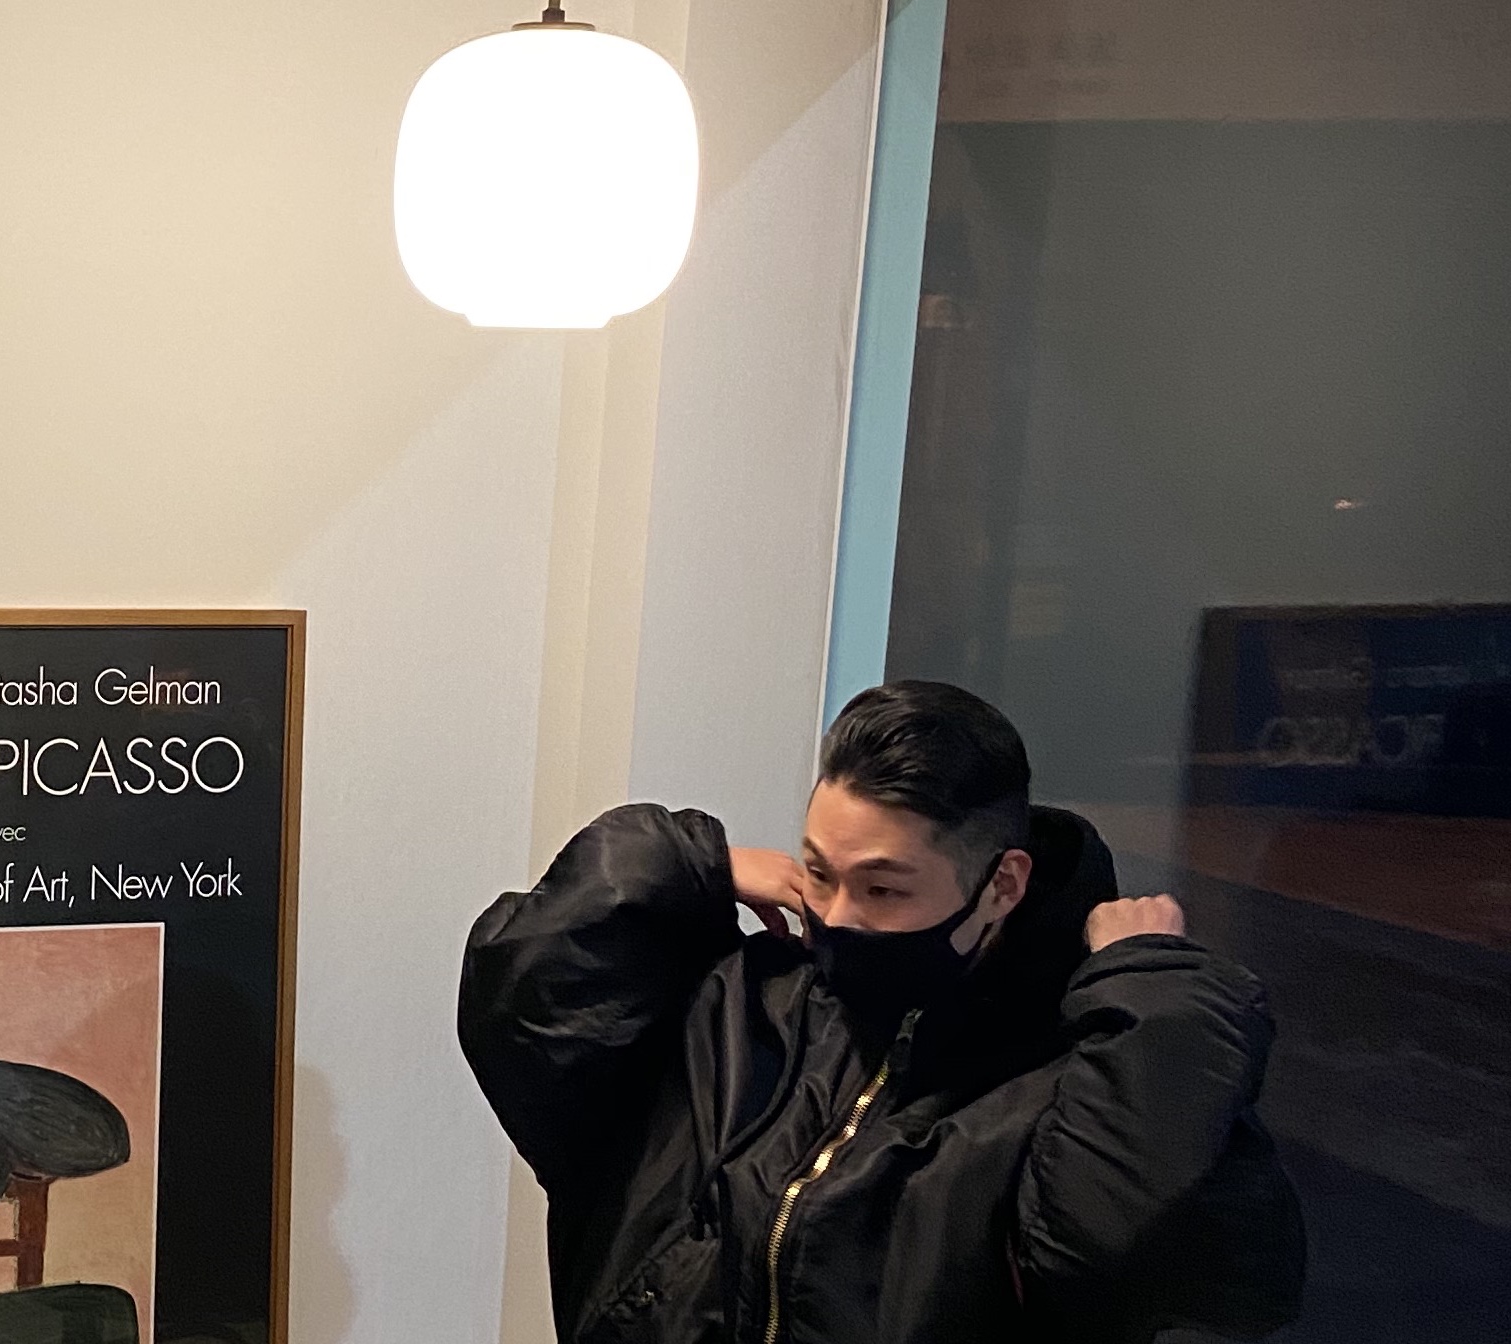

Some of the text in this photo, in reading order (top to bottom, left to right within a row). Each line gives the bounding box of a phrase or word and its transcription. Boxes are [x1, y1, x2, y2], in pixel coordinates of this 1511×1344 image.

[94, 665, 222, 706] Gelman
[22, 865, 75, 910] Art,
[90, 863, 174, 902] New
[180, 857, 243, 899] York
